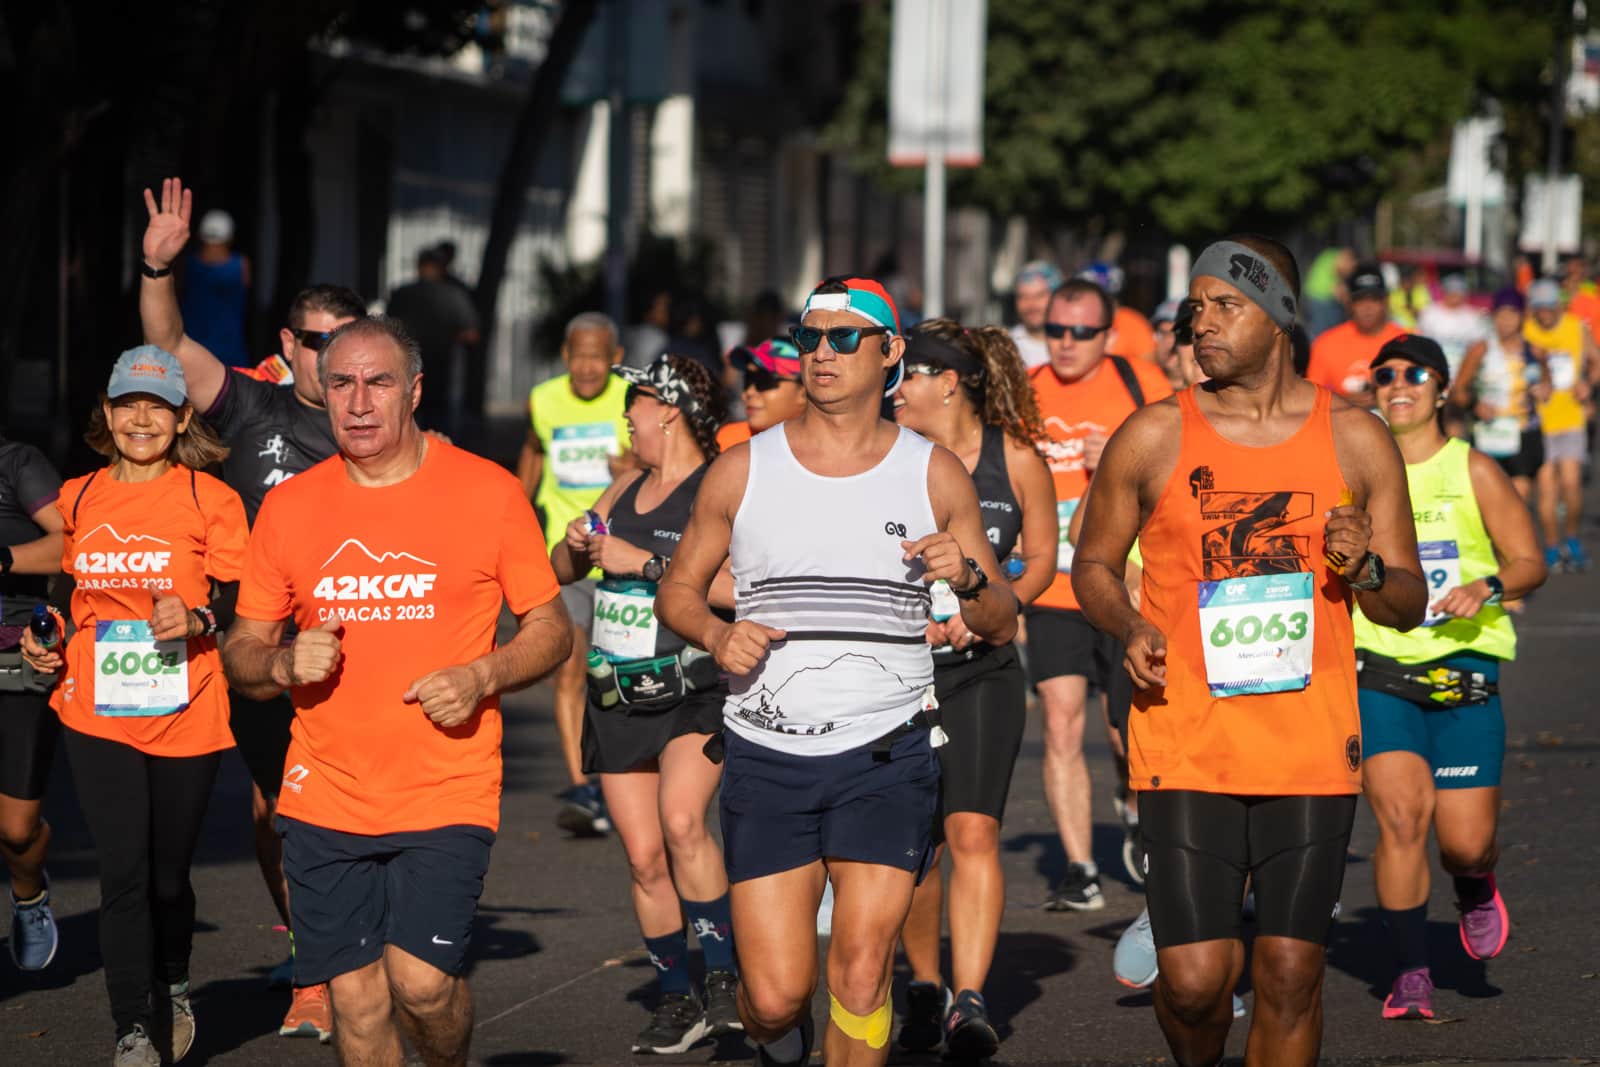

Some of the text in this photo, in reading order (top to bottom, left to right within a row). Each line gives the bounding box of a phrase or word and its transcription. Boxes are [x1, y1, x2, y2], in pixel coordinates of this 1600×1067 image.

[74, 551, 171, 573] 42KCAF
[77, 578, 138, 590] CARACAS
[312, 574, 437, 600] 42KCAF
[318, 603, 435, 622] CARACAS 2023
[595, 599, 653, 629] 4402
[1210, 611, 1309, 648] 6063
